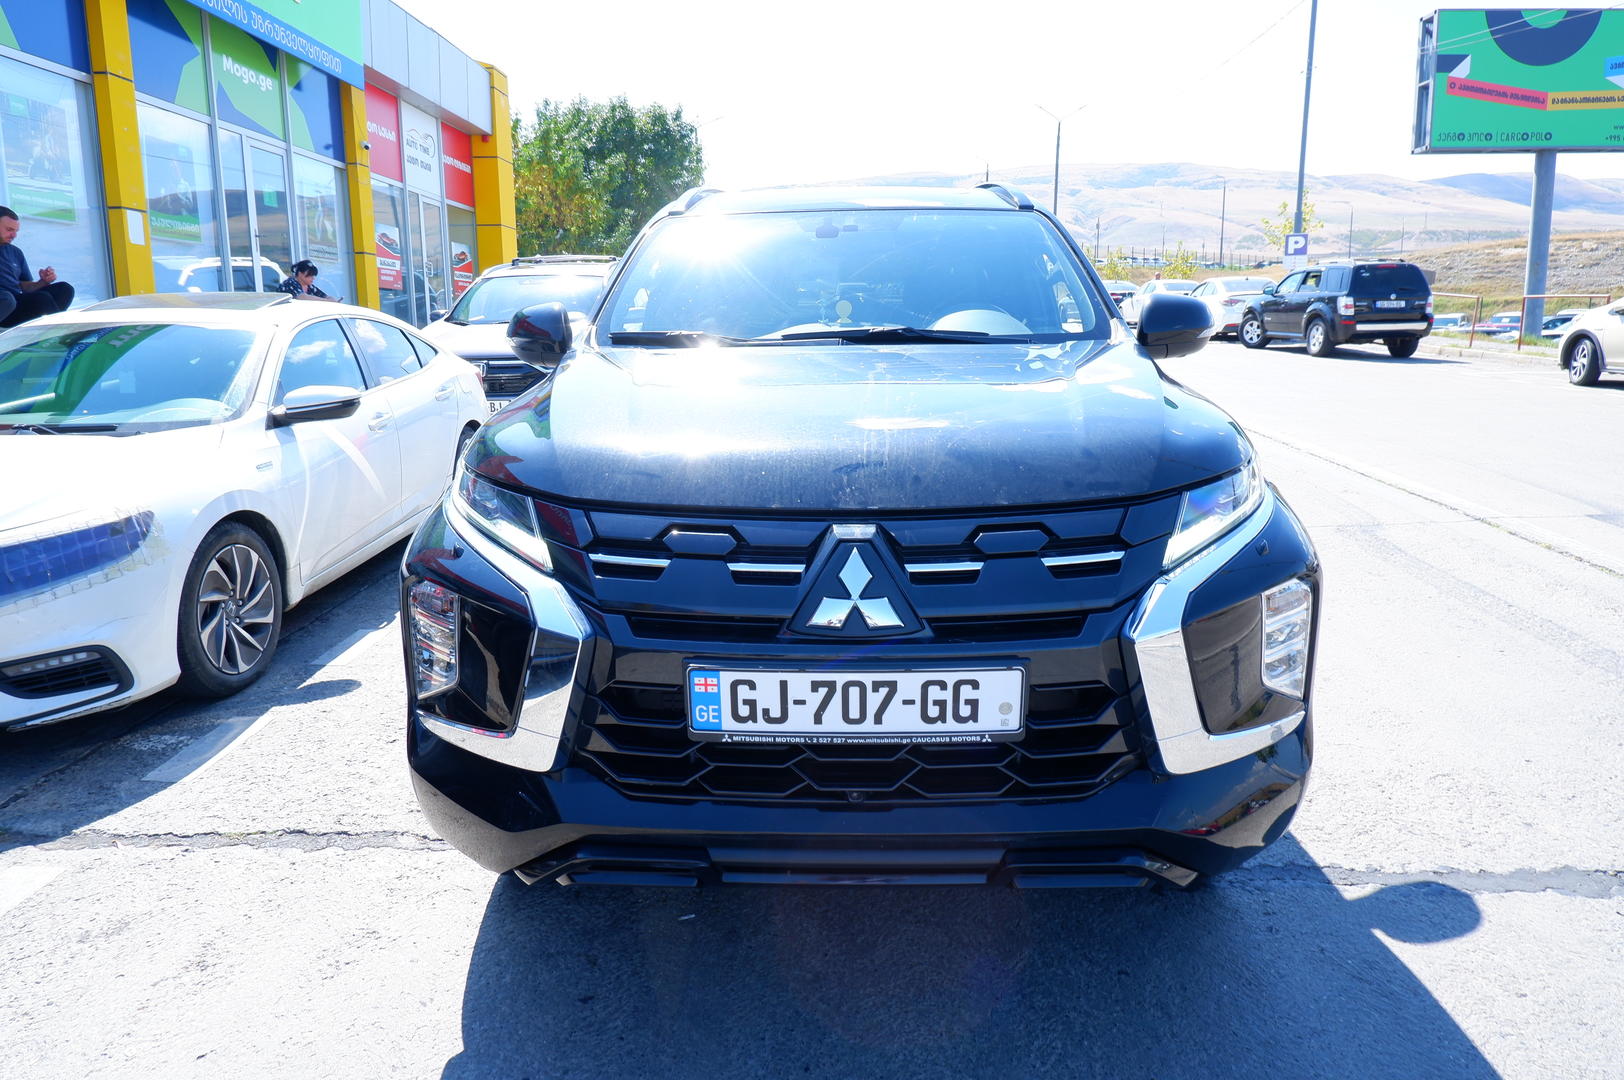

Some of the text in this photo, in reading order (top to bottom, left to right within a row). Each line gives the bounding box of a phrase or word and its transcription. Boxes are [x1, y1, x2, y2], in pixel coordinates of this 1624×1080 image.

[222, 54, 273, 92] Mogo.ge
[1288, 236, 1306, 254] P
[729, 678, 980, 725] GJ-707-GG
[695, 705, 719, 723] GE
[732, 735, 774, 743] MITSUBISHI
